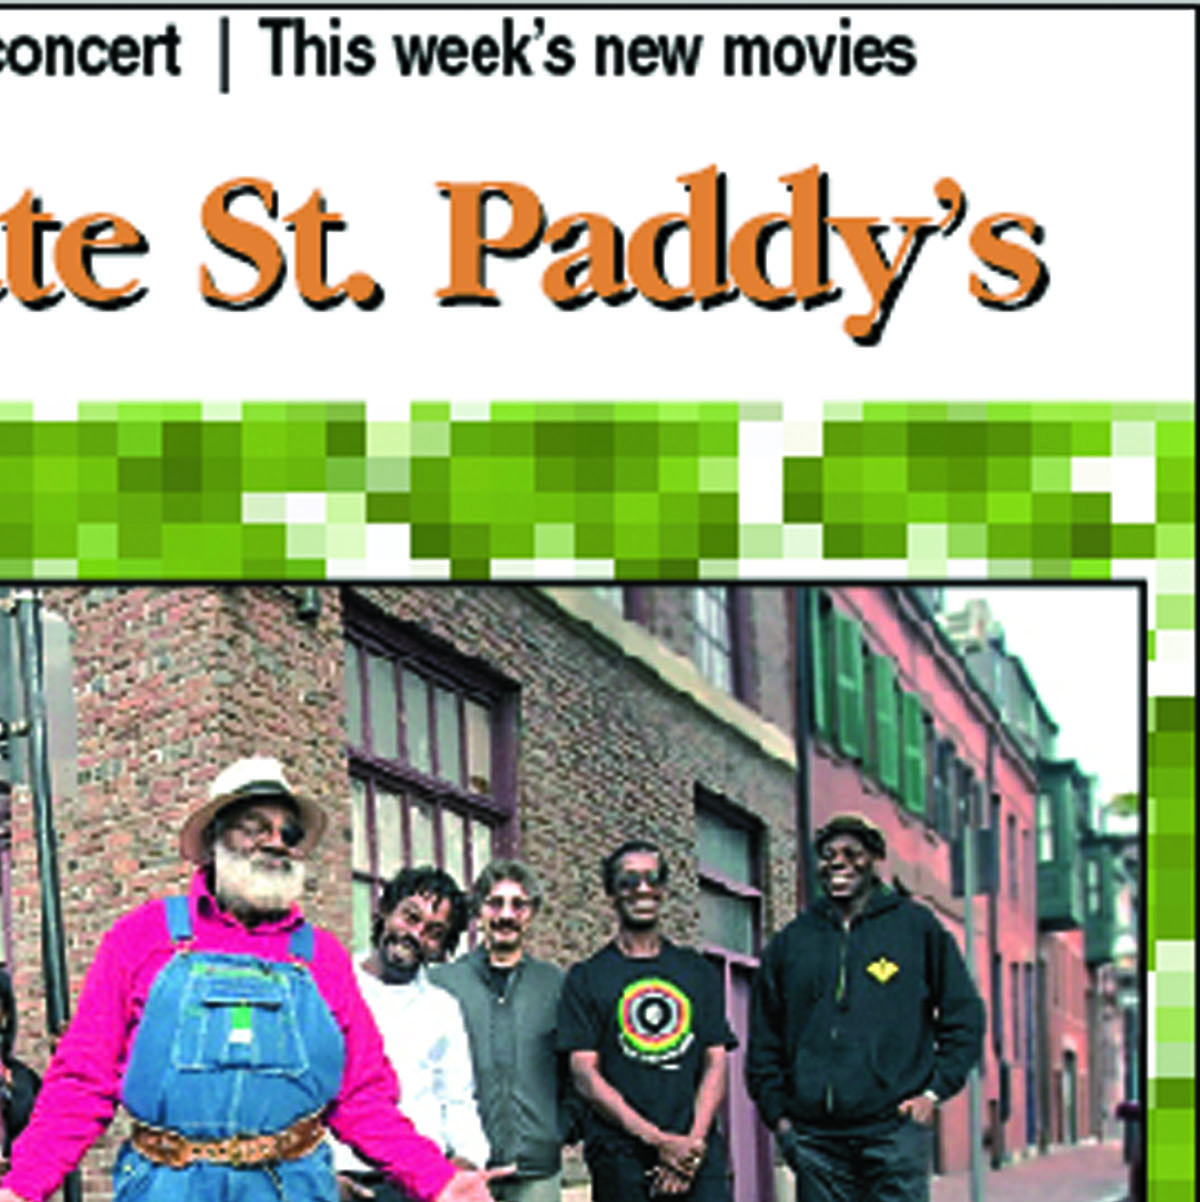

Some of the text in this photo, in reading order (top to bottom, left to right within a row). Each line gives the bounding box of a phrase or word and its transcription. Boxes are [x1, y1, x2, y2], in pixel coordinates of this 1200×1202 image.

[258, 17, 377, 77] This
[392, 17, 576, 77] week’s
[596, 35, 704, 77] new
[725, 17, 917, 77] movies
[199, 177, 386, 313] St.
[435, 164, 1052, 348] Paddy’s
